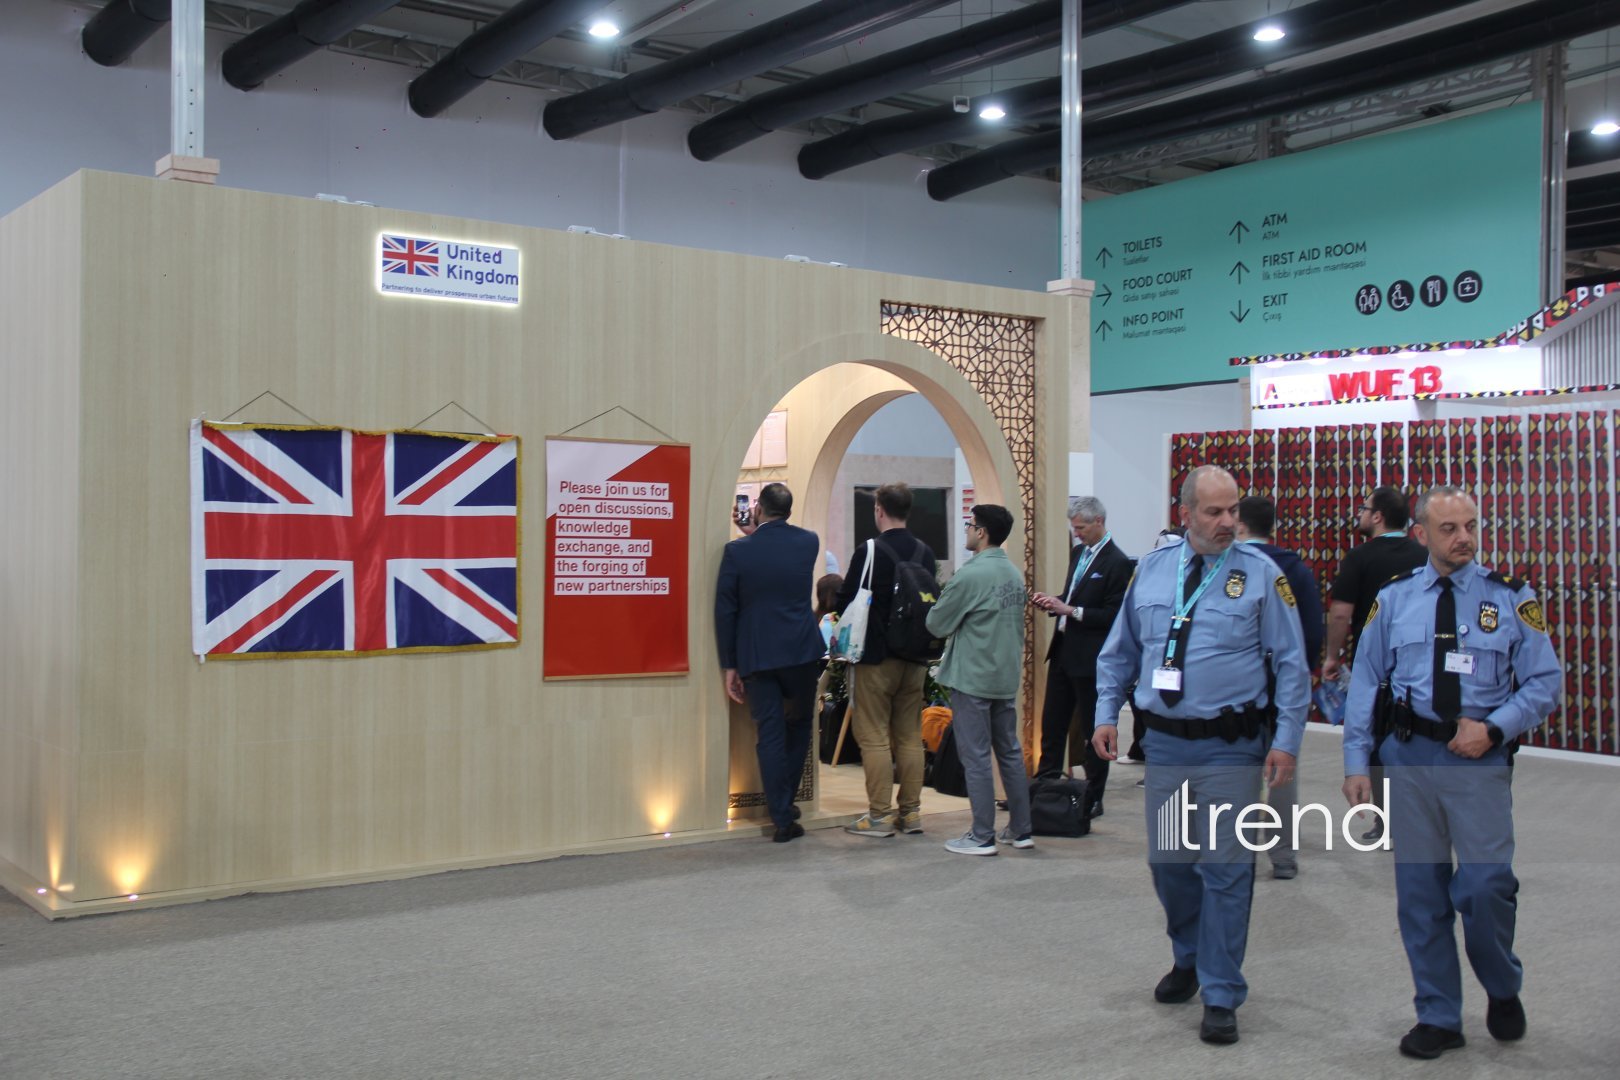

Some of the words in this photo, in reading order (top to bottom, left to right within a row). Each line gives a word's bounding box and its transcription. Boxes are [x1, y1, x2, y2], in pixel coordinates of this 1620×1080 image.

[1262, 212, 1288, 228] ATM
[1262, 230, 1279, 241] ATM
[1122, 236, 1162, 254] TOILETS
[446, 244, 502, 264] United
[1262, 251, 1294, 267] FIRST
[1298, 248, 1320, 262] AID
[1325, 241, 1367, 258] ROOM
[446, 264, 519, 286] Kingdom
[1122, 275, 1153, 290] FOOD
[1156, 268, 1193, 285] COURT
[381, 283, 414, 293] Partnering
[423, 287, 443, 295] deliver
[445, 290, 478, 298] prosperous
[1263, 293, 1288, 308] EXIT
[1123, 313, 1148, 327] INFO
[1151, 308, 1184, 323] POINT
[1328, 369, 1404, 401] WUF
[1409, 365, 1443, 395] 13
[559, 480, 601, 494] Please
[605, 482, 629, 497] join
[632, 486, 647, 496] us
[650, 485, 667, 496] for
[558, 503, 590, 515] open
[595, 502, 671, 517] discussions,
[558, 520, 629, 536] knowledge
[557, 540, 624, 555] exchange,
[627, 541, 650, 553] and
[557, 560, 578, 572] the
[582, 559, 628, 574] forging
[632, 560, 645, 572] of
[556, 582, 584, 592] new
[588, 579, 667, 594] partnerships
